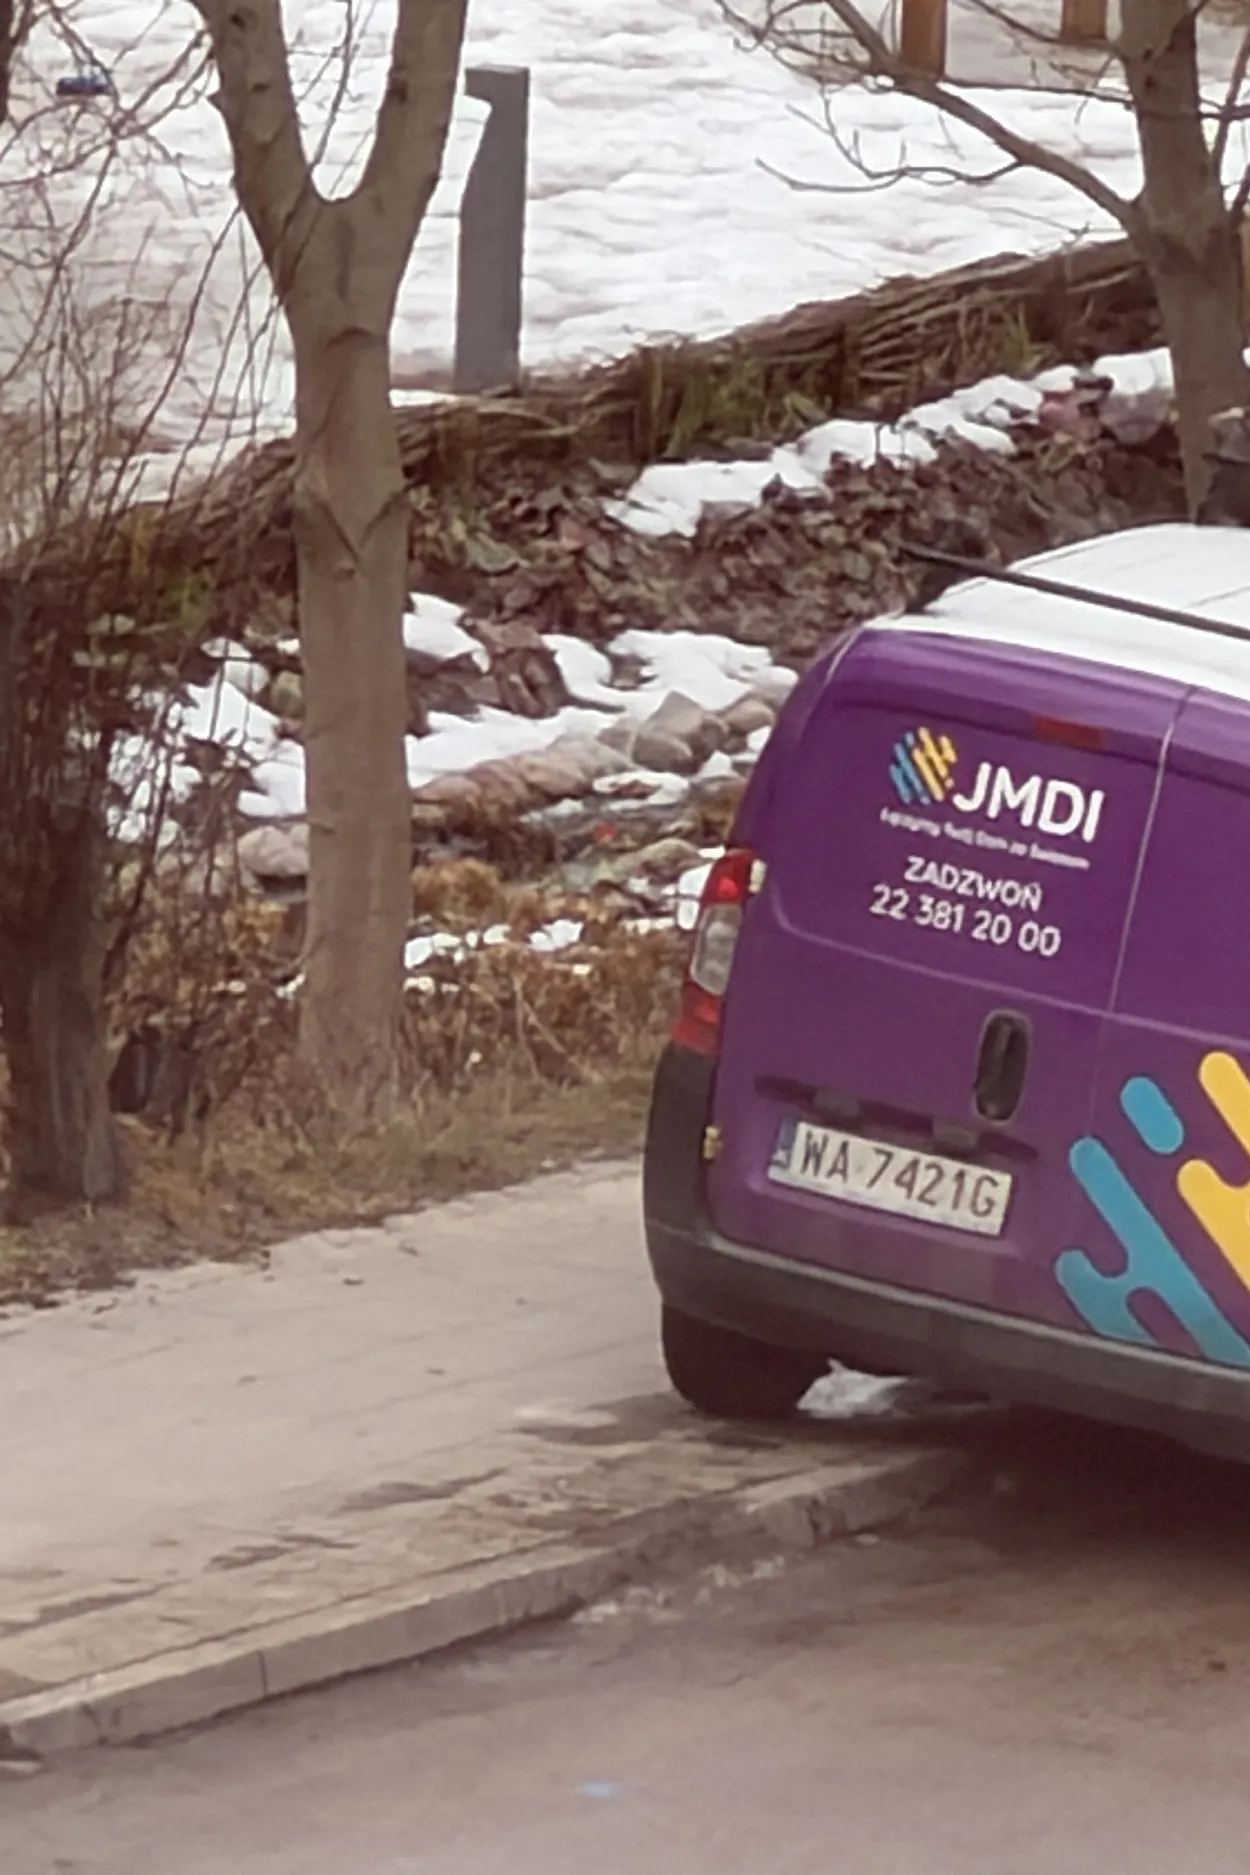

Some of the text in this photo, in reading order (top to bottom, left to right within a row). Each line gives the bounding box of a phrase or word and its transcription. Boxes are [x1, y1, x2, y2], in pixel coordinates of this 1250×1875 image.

[952, 762, 1104, 842] JMDI
[869, 884, 1062, 957] 22 381 20 00
[801, 1130, 1000, 1218] WA 7421G
